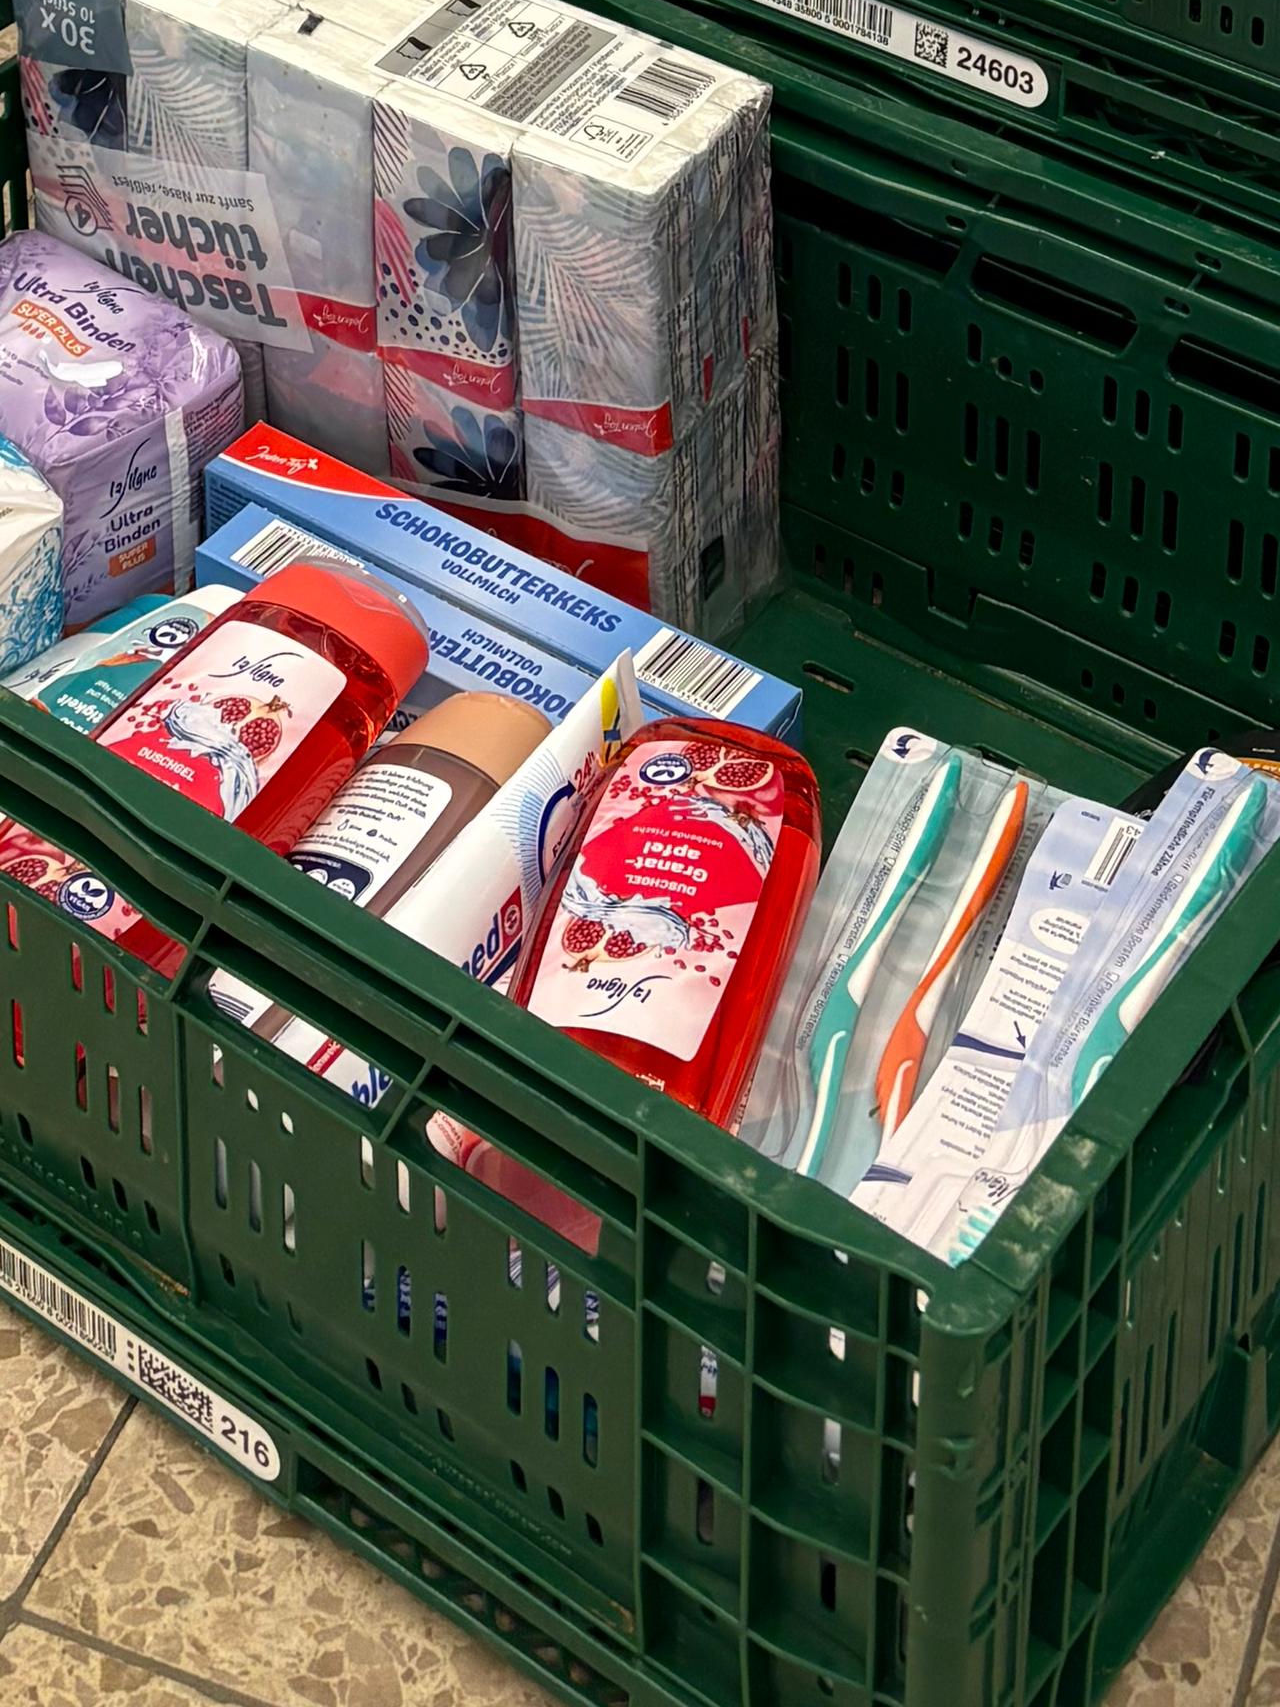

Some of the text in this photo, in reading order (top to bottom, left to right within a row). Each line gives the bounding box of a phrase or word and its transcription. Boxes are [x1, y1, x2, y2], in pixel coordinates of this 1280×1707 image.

[39, 7, 96, 55] 30 x
[78, 7, 97, 25] 10
[956, 46, 1034, 96] 24603
[110, 174, 254, 212] Sanft zur Nase, reißfest
[75, 203, 90, 230] 4
[125, 202, 268, 273] tücher
[11, 271, 137, 355] Ultra Binden
[18, 300, 88, 357] SUPER PLUS
[102, 517, 162, 555] Binden
[110, 503, 155, 535] Ultra
[118, 541, 151, 561] SUPER
[120, 556, 148, 574] PLUS
[373, 500, 623, 634] SCHOKOBUTTERKEKS
[438, 558, 523, 607] VOLLMILCH
[460, 627, 544, 677] VOLLMILCH
[135, 744, 198, 783] DUSCHGEL
[624, 854, 708, 882] Granat-
[642, 838, 701, 861] apfel
[624, 872, 698, 897] DUSCHGEL
[219, 1415, 270, 1469] 216
